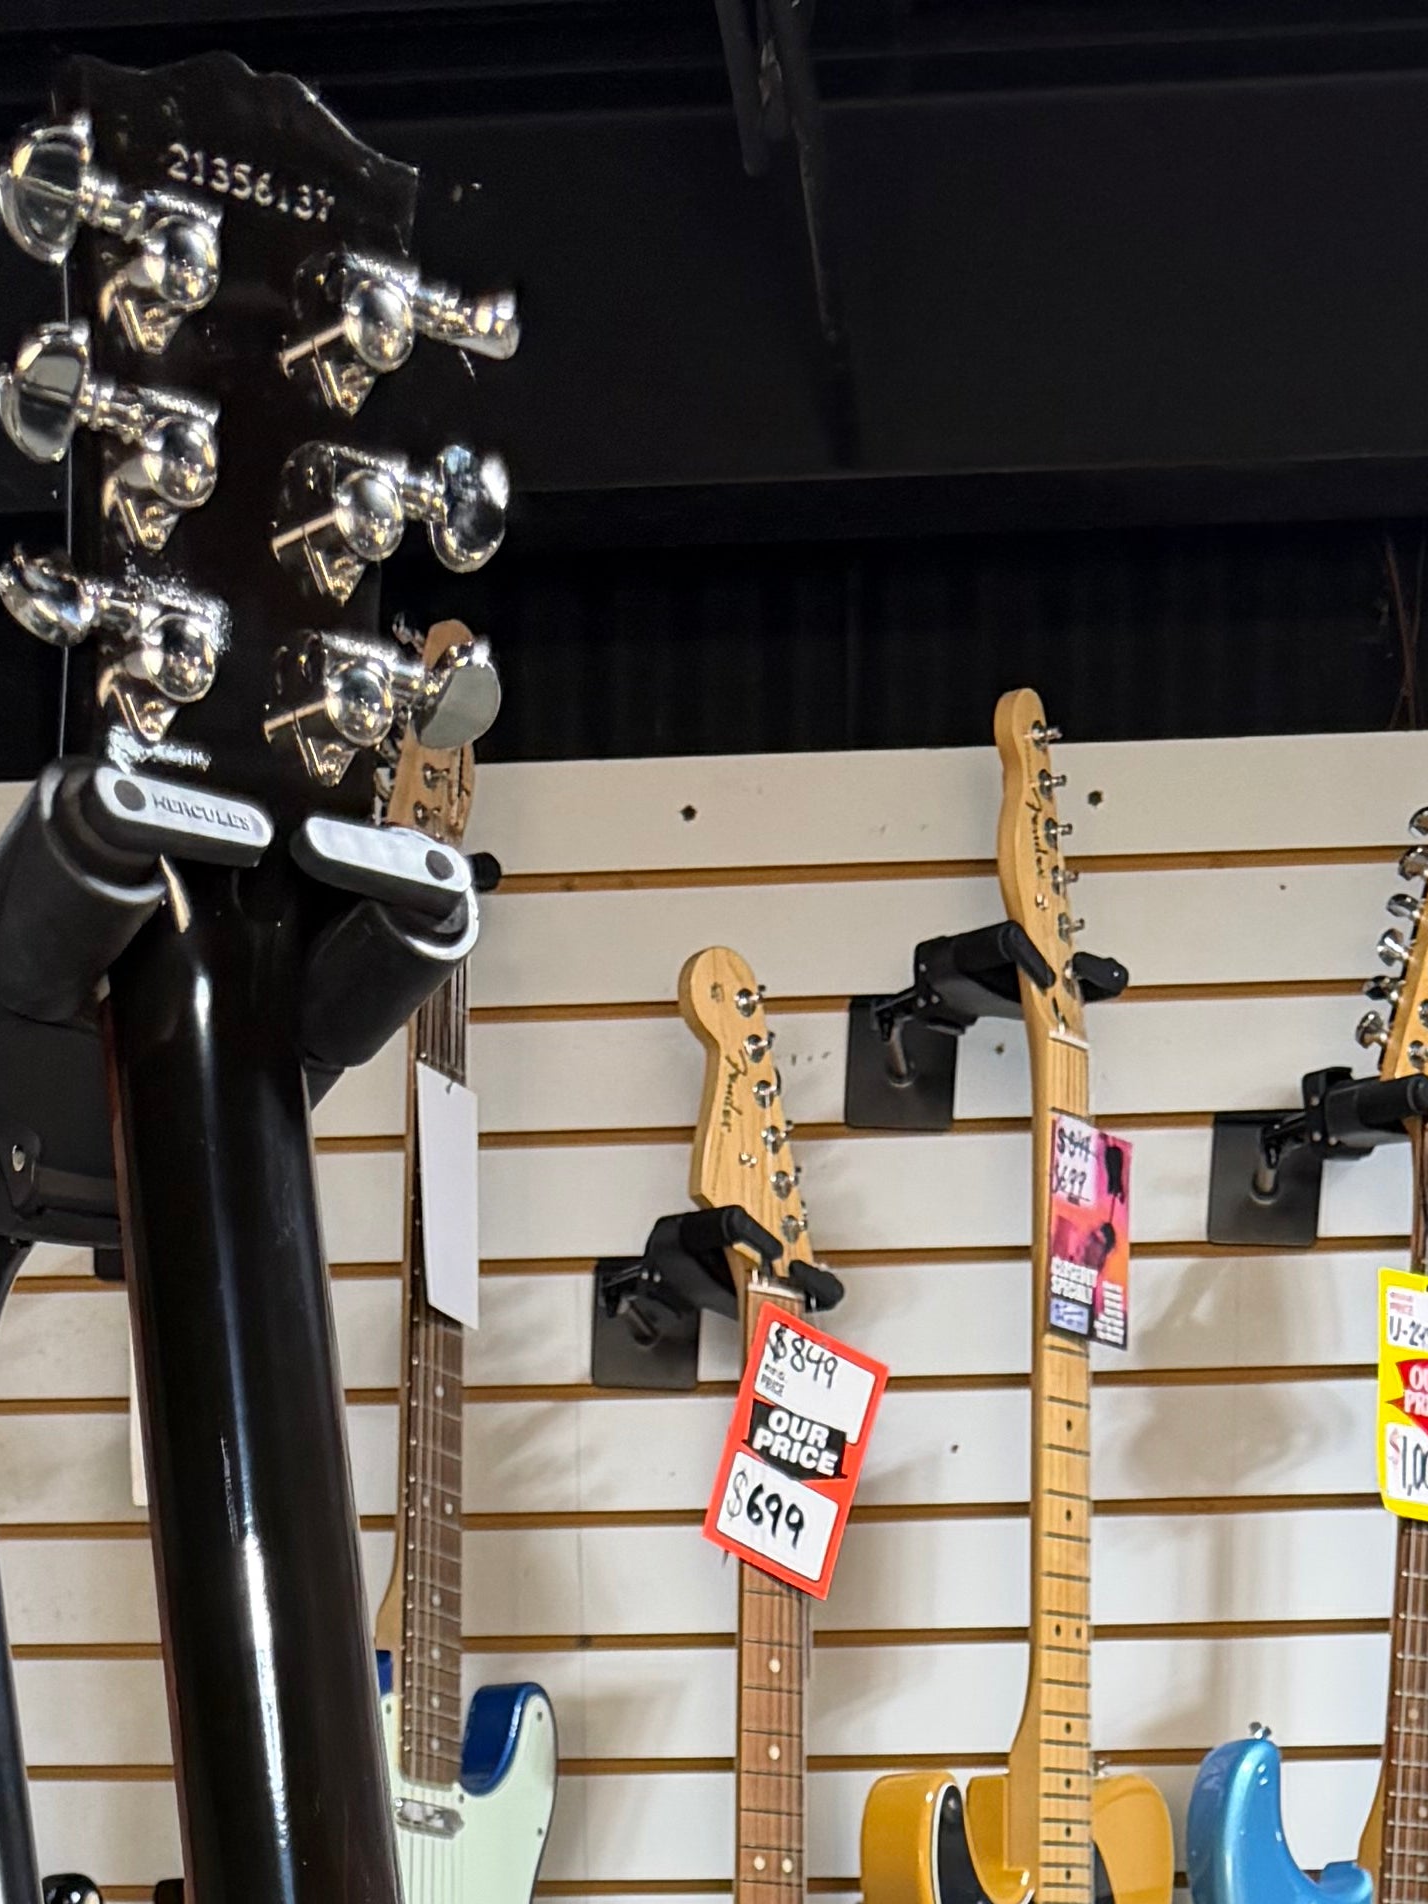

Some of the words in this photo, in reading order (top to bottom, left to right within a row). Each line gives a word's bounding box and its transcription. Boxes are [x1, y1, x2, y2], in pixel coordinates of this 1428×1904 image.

[151, 793, 252, 832] HERCULES
[768, 1325, 838, 1389] $849
[752, 1427, 838, 1478] PRICE
[768, 1409, 830, 1449] OUR
[726, 1467, 804, 1550] $699
